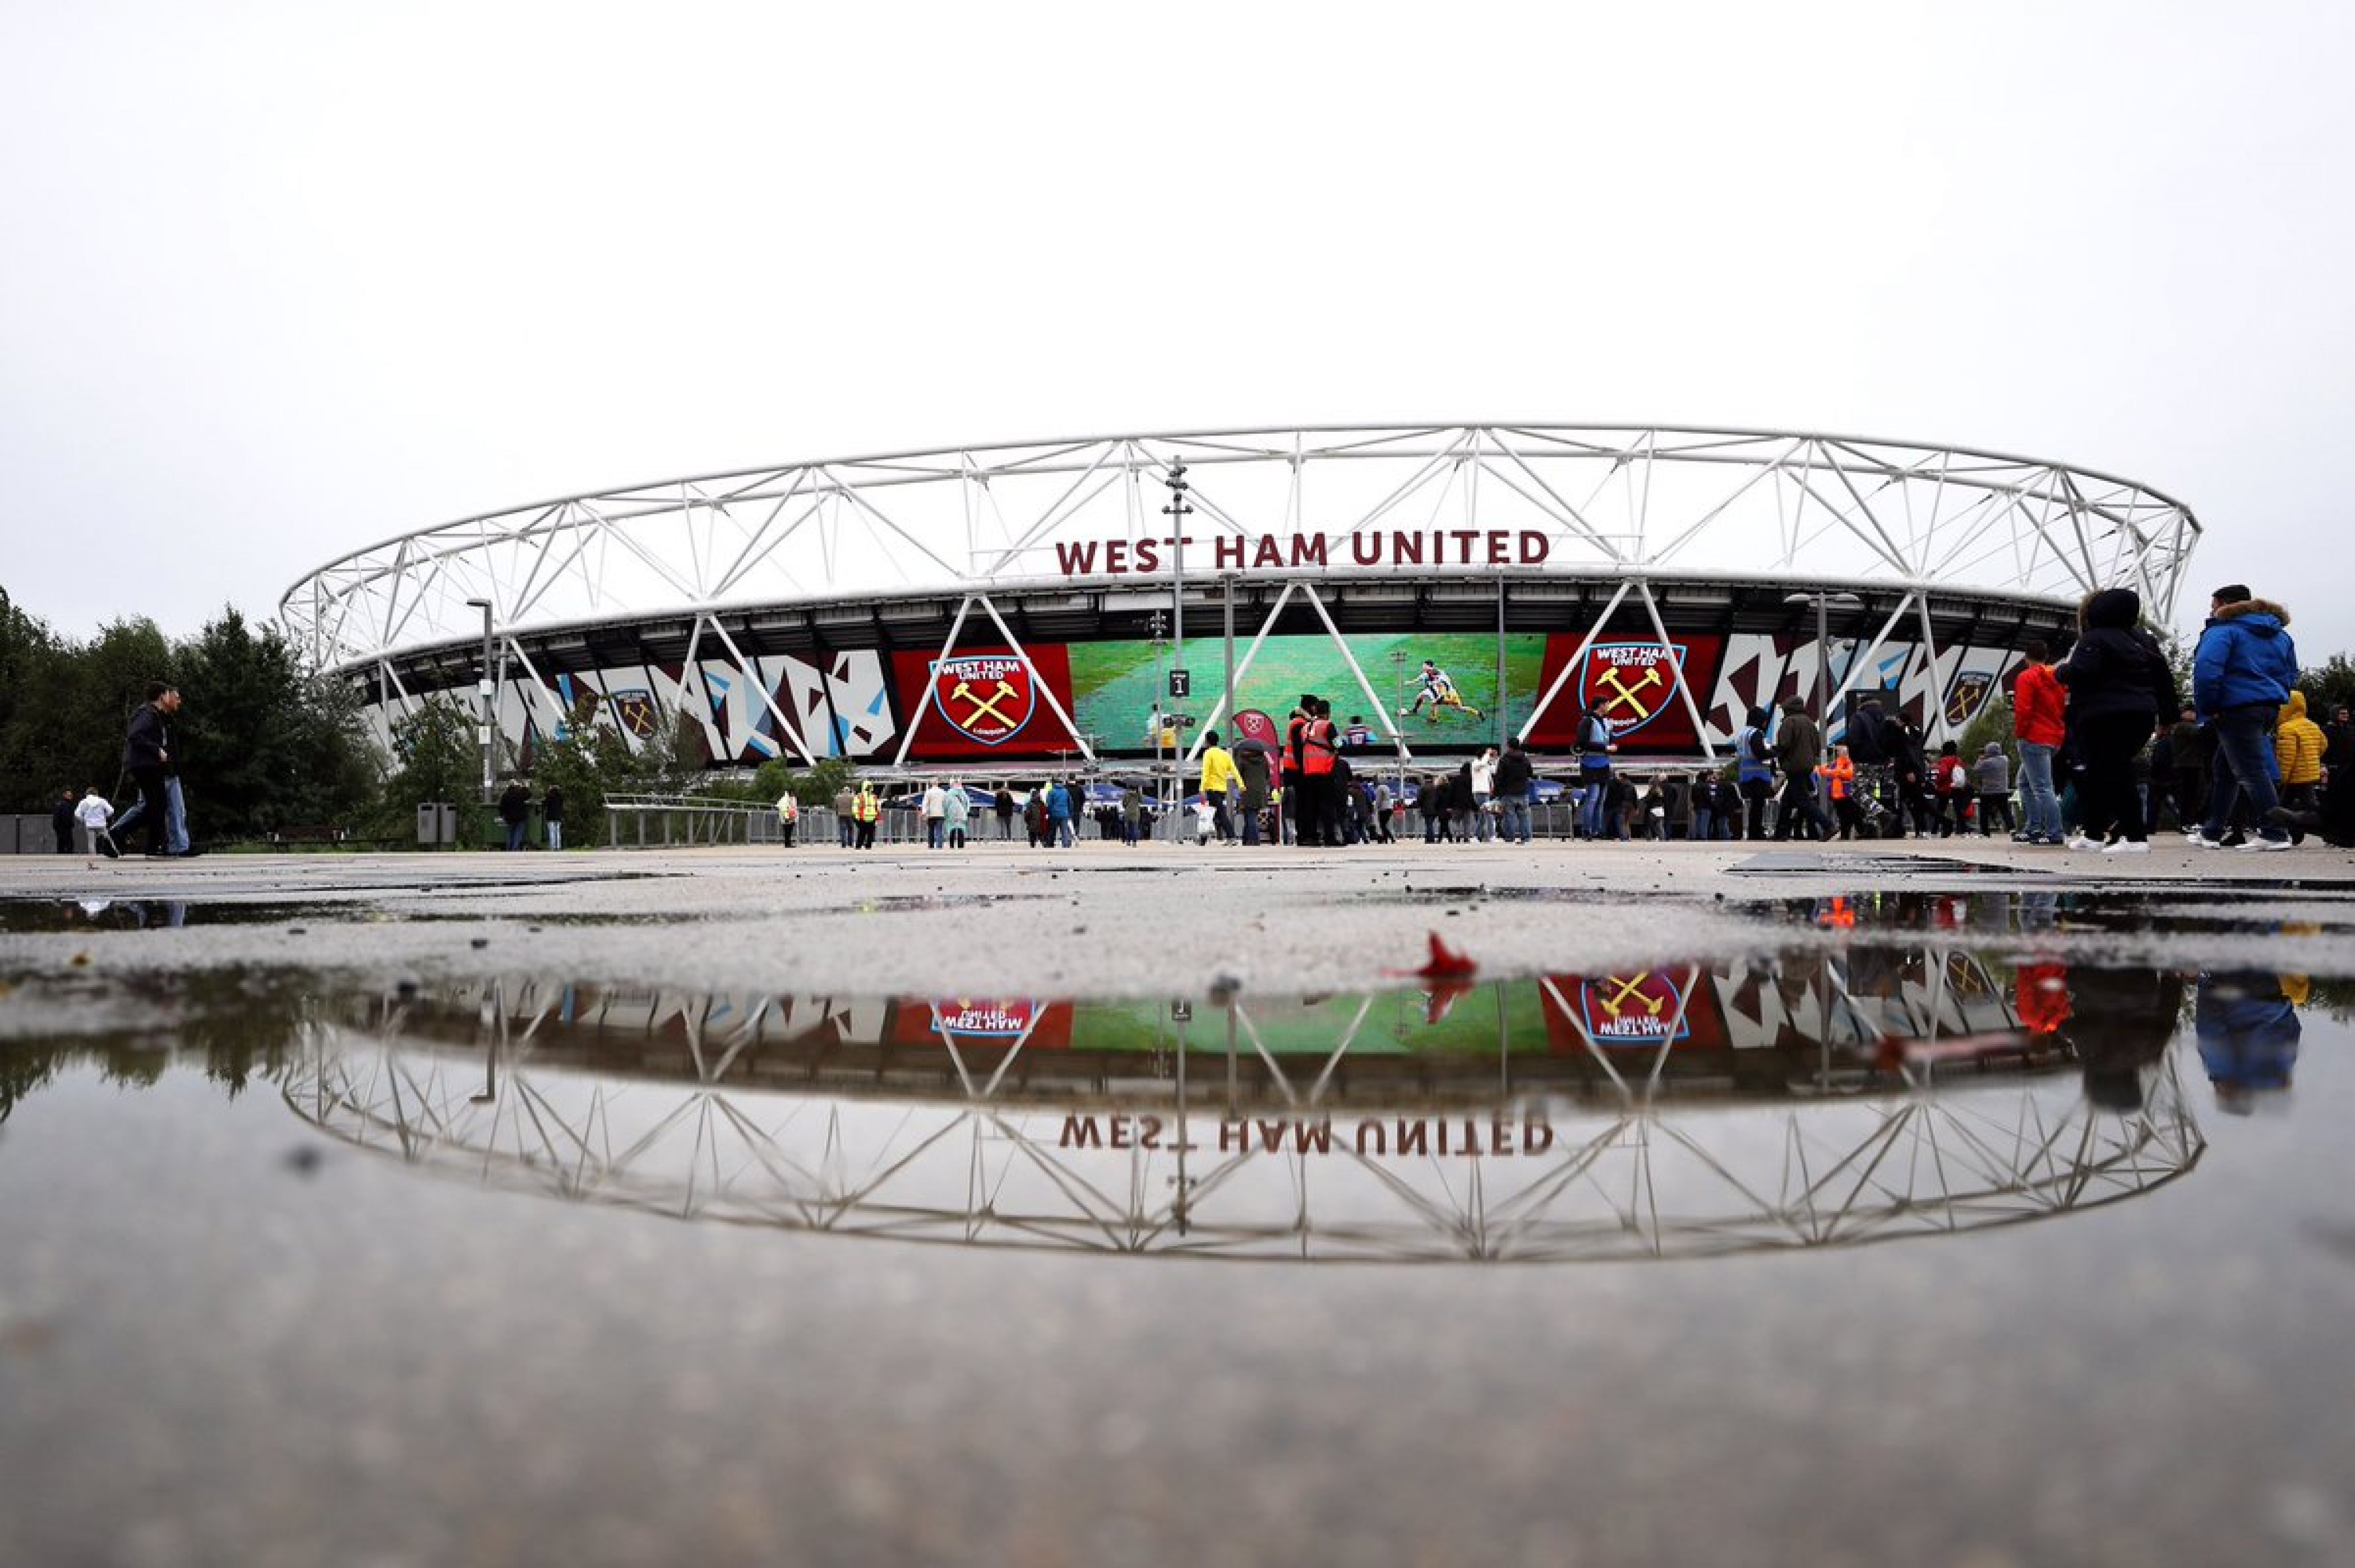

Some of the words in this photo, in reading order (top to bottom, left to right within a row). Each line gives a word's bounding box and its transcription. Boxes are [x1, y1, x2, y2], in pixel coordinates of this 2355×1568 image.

[1215, 533, 1327, 569] HAM
[1352, 530, 1549, 565] UNITED
[1597, 647, 1637, 659] WEST
[942, 661, 980, 674] WEST
[982, 661, 1021, 672] HAM
[1175, 678, 1184, 693] 1
